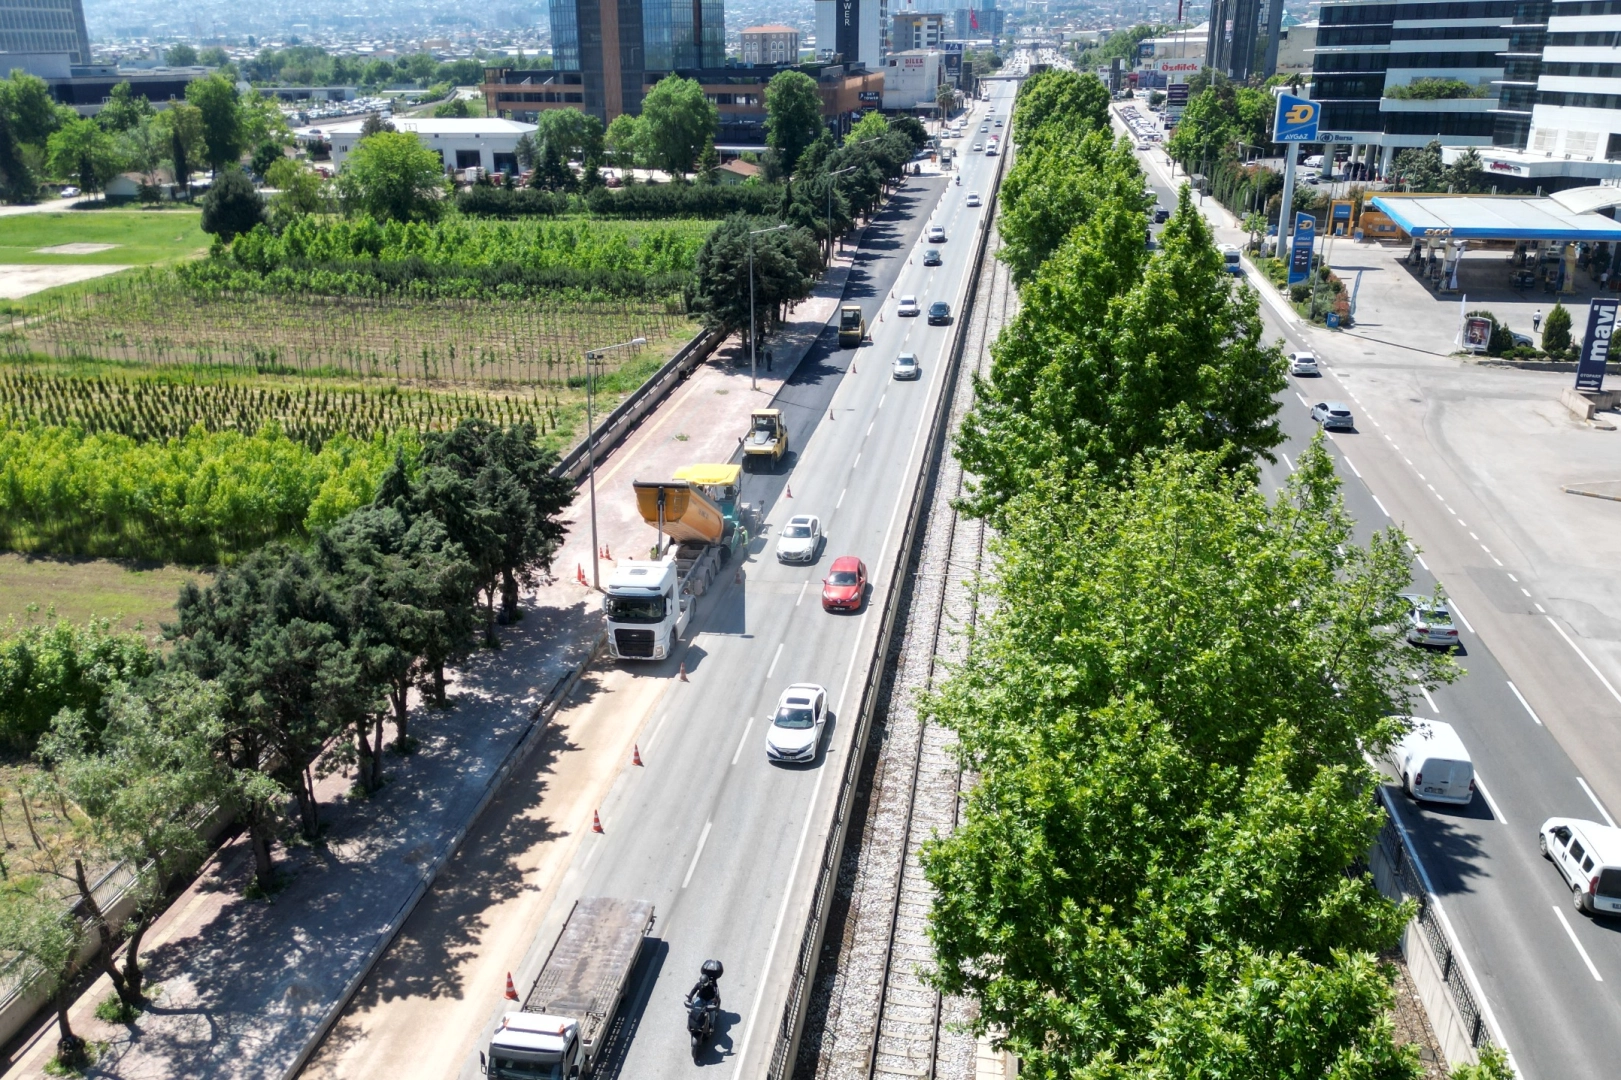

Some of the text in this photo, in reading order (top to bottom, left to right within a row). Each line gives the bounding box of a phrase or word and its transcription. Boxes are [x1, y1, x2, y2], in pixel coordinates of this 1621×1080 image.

[843, 0, 852, 26] WER
[1162, 62, 1198, 71] Özdilek
[1590, 304, 1616, 361] mavi
